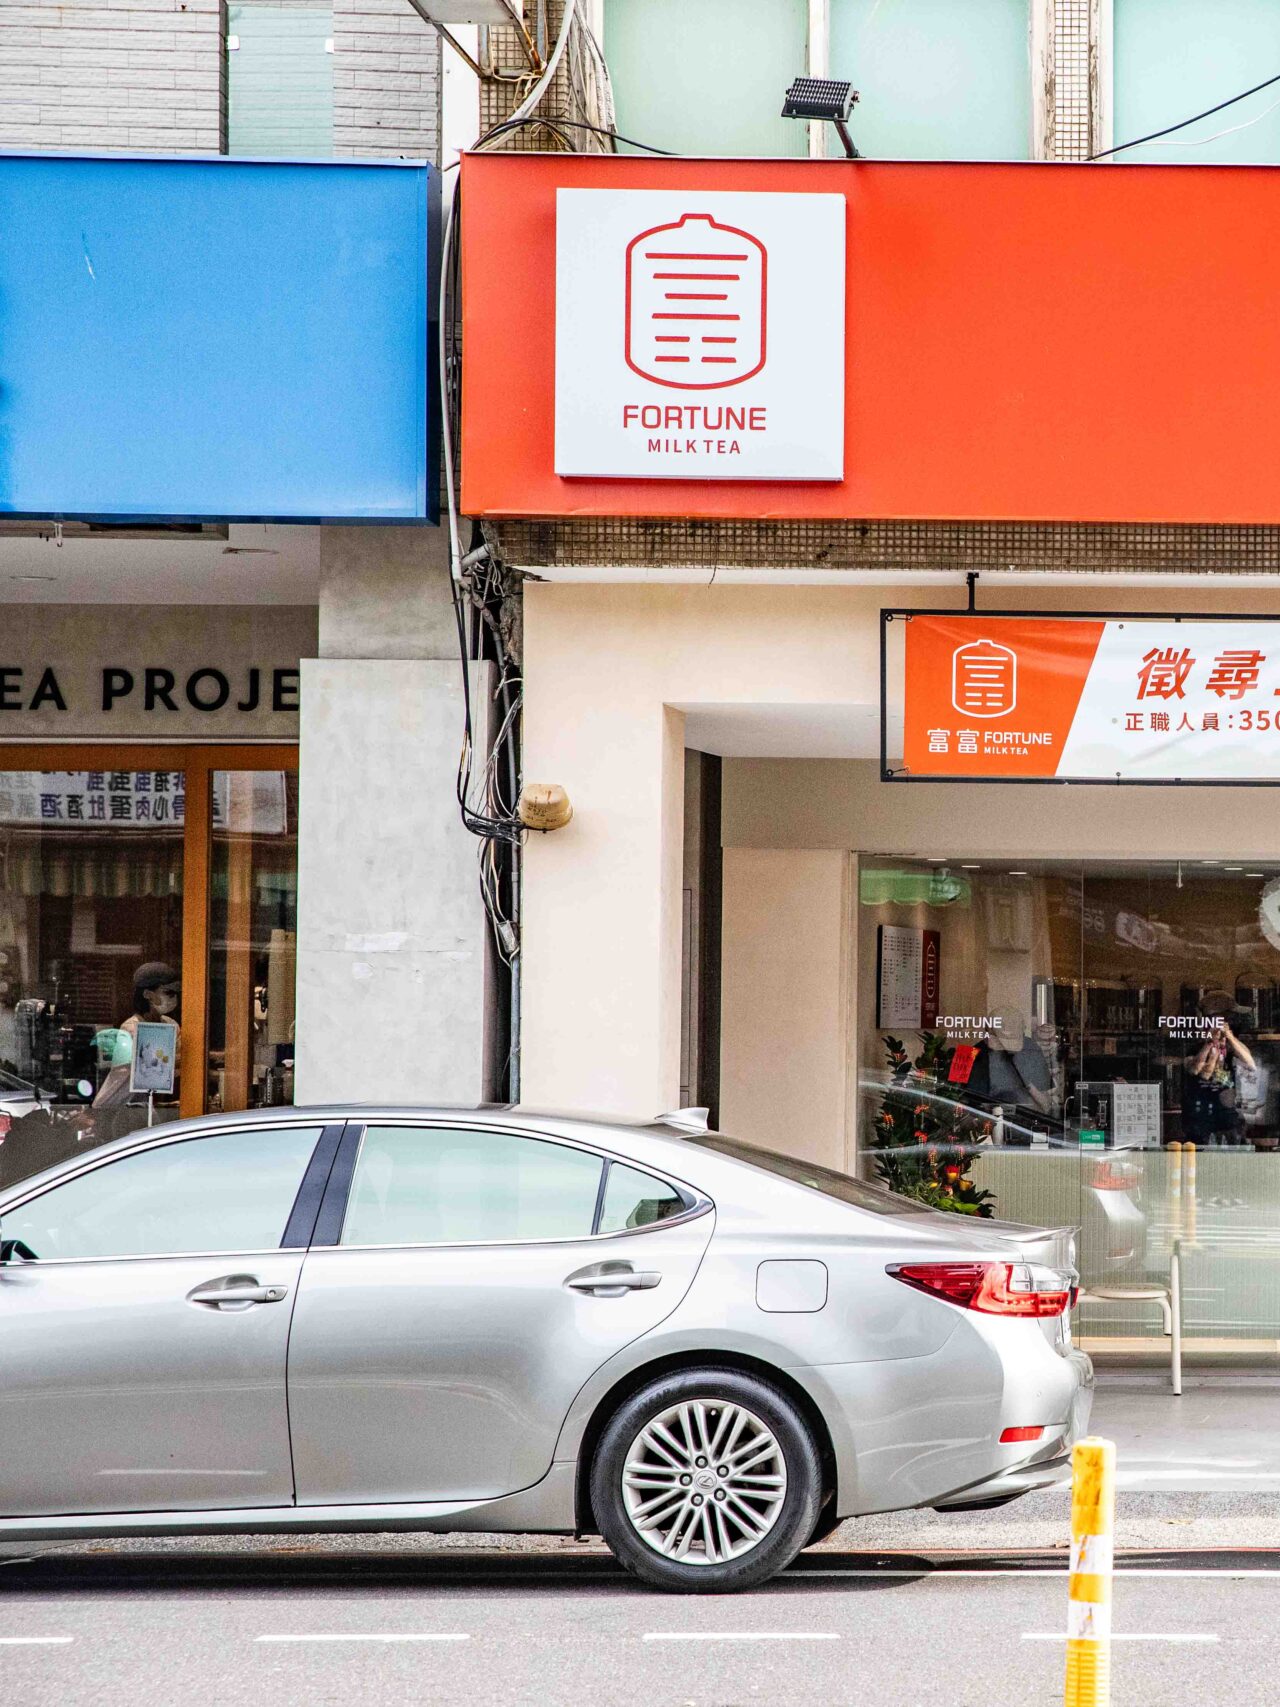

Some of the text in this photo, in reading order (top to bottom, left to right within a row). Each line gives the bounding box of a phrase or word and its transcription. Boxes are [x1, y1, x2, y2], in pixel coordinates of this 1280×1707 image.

[623, 404, 767, 431] FORTUNE
[647, 438, 741, 454] MILK TEA
[102, 667, 299, 712] PROJE
[927, 728, 980, 754] 富富
[984, 731, 1052, 745] FORTUNE
[984, 746, 1028, 755] MILK TEA
[935, 1016, 1002, 1029] FORTUNE
[1158, 1016, 1225, 1029] FORTUNE
[947, 1031, 990, 1039] MILK TEA
[1169, 1031, 1213, 1039] MILK TEA
